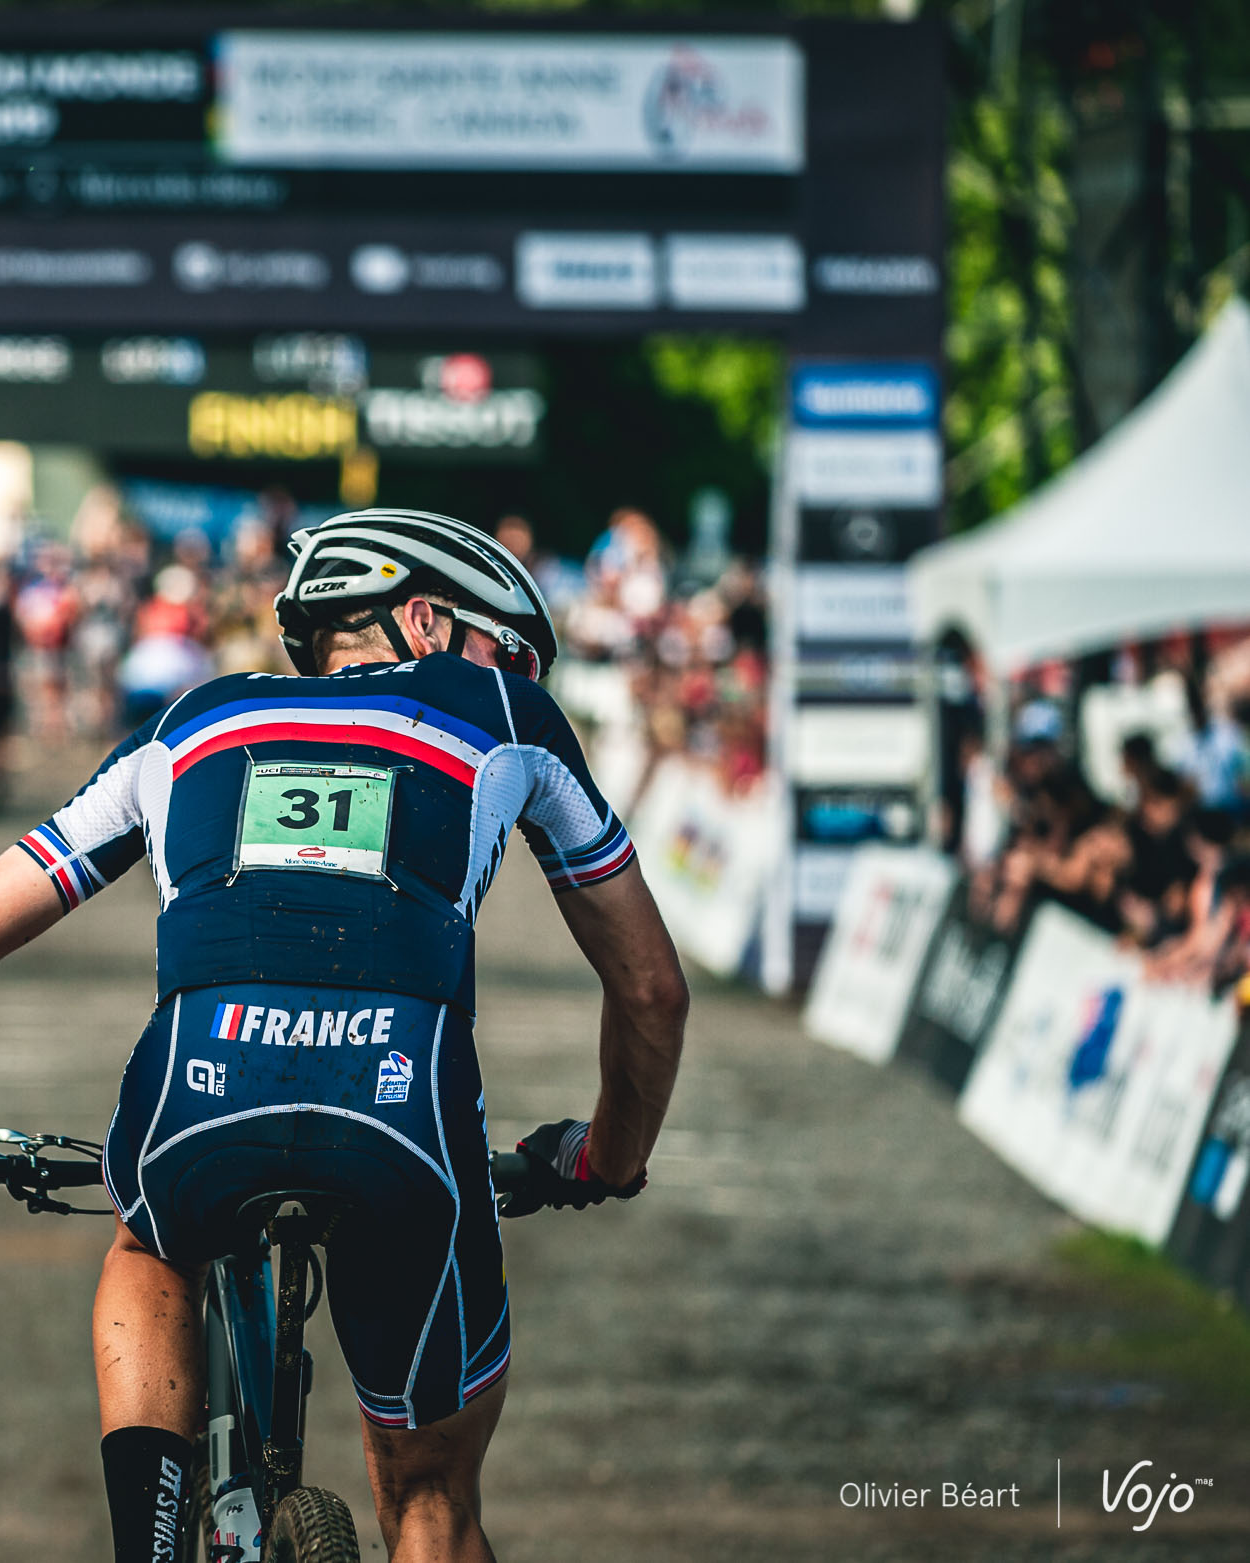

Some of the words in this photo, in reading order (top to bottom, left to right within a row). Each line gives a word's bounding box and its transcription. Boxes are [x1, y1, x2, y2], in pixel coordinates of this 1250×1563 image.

[304, 581, 348, 595] LAZER
[276, 788, 353, 832] 31
[240, 1005, 395, 1047] FRANCE
